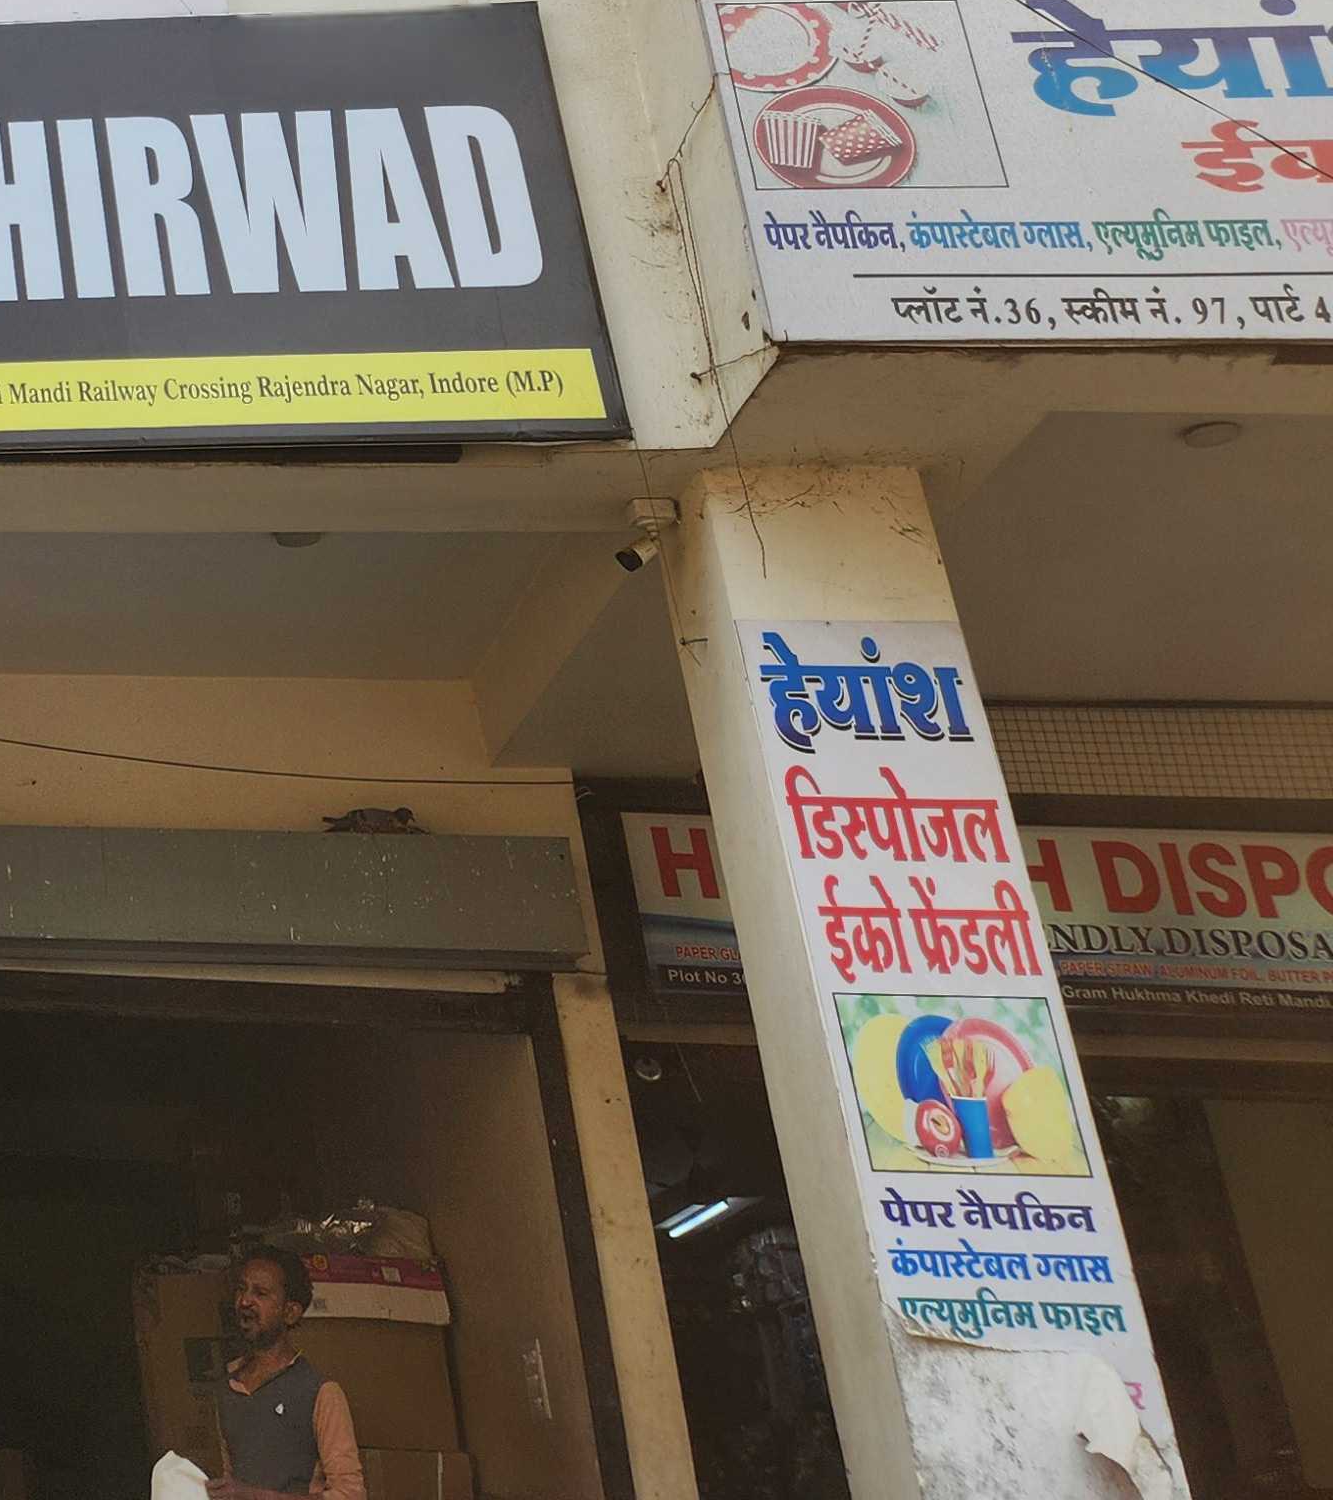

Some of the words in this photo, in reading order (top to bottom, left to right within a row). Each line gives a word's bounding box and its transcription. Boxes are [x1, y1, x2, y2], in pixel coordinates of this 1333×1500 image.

[764, 211, 811, 250] पेपर
[891, 286, 962, 326] प्लॉट
[1060, 286, 1139, 327] स्कीम
[1248, 284, 1305, 323] पार्ट
[8, 380, 72, 405] Mandi
[77, 377, 158, 409] Railway
[163, 375, 253, 406] Crossing
[256, 371, 353, 404] Rajendra
[355, 371, 425, 403] Nagar,
[428, 371, 499, 395] Indore
[504, 368, 565, 398] (M.P)
[760, 631, 974, 754] हेयांश
[784, 765, 1010, 862] डिस्पोजल
[818, 875, 912, 984] ईको
[667, 968, 700, 983] Plot
[880, 1187, 956, 1230] पेपर
[958, 1189, 1096, 1233] नैपकिन
[888, 1237, 1029, 1281] कंपास्टेबल
[1036, 1254, 1114, 1284] ग्लास
[1039, 1301, 1127, 1337] फाइल
